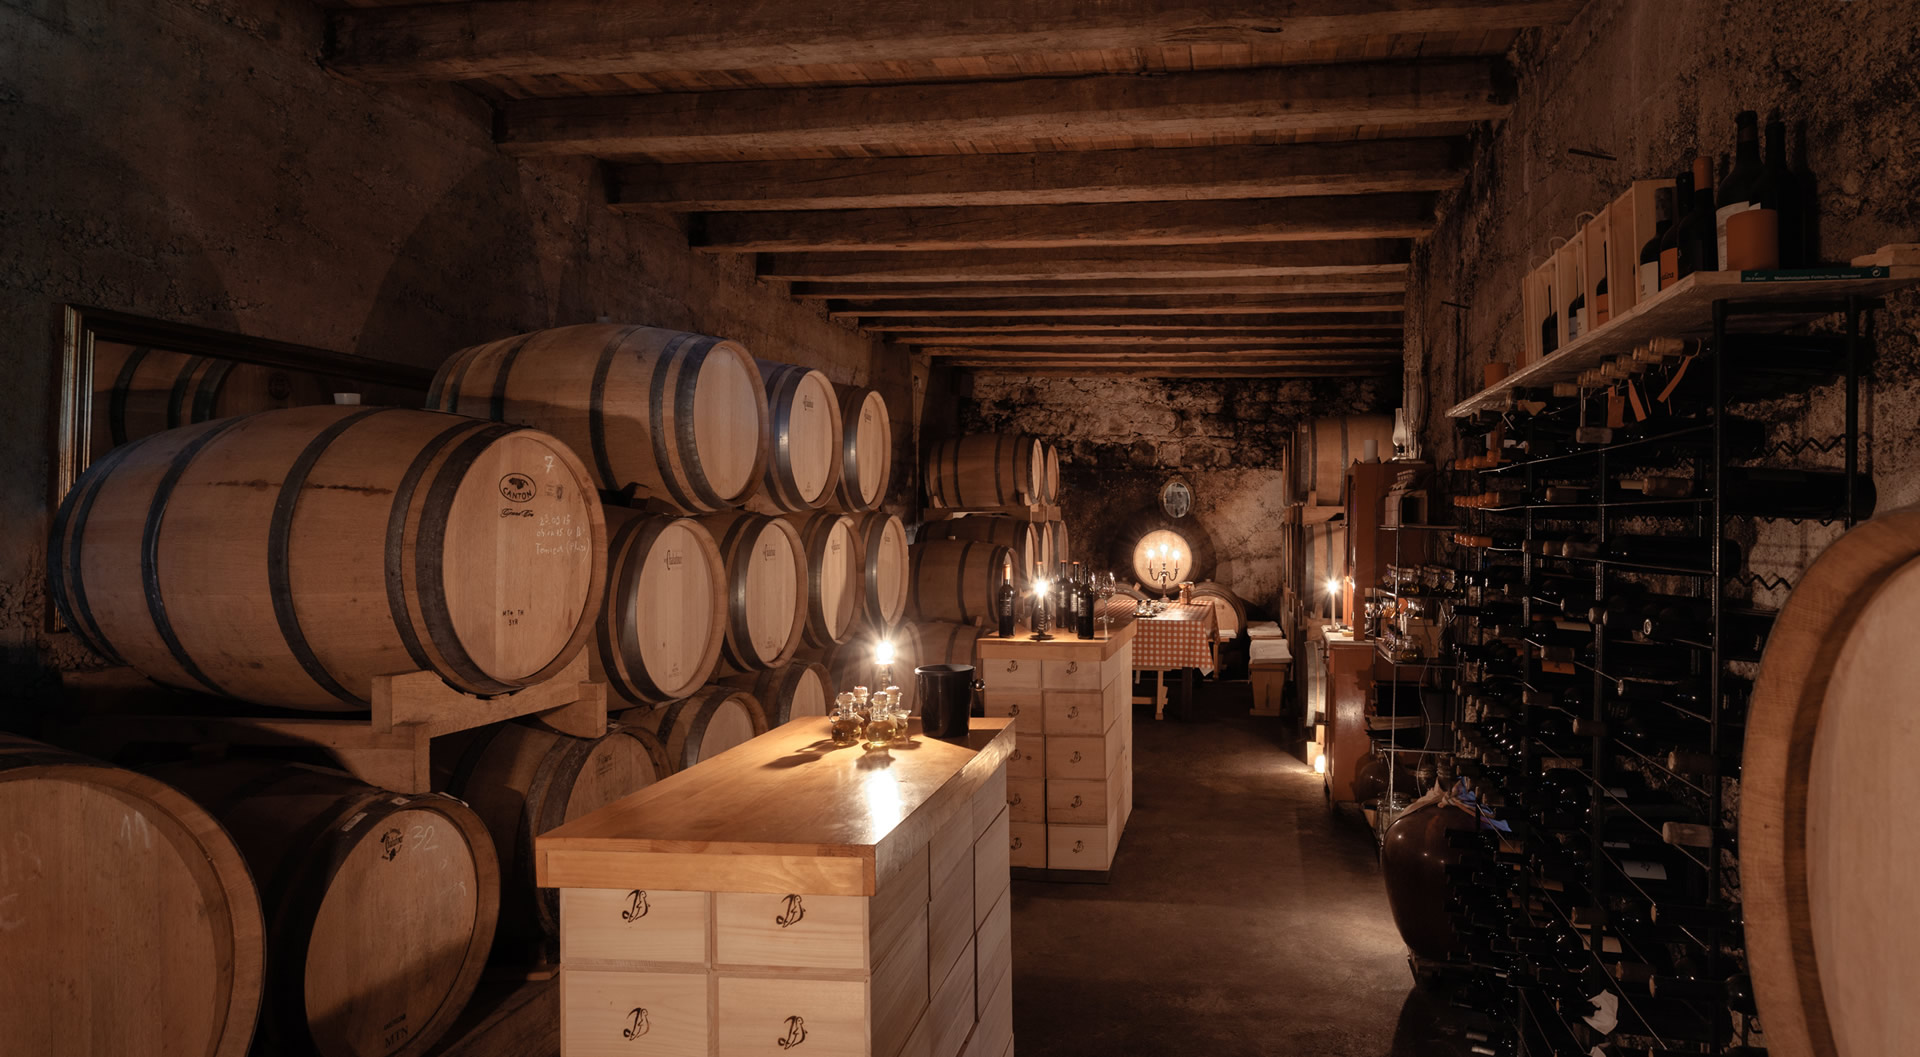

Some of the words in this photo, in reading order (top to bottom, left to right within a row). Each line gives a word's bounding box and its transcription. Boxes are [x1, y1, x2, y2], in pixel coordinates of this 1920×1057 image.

[544, 455, 556, 474] 7
[502, 486, 532, 500] CANTON
[410, 825, 439, 851] 32
